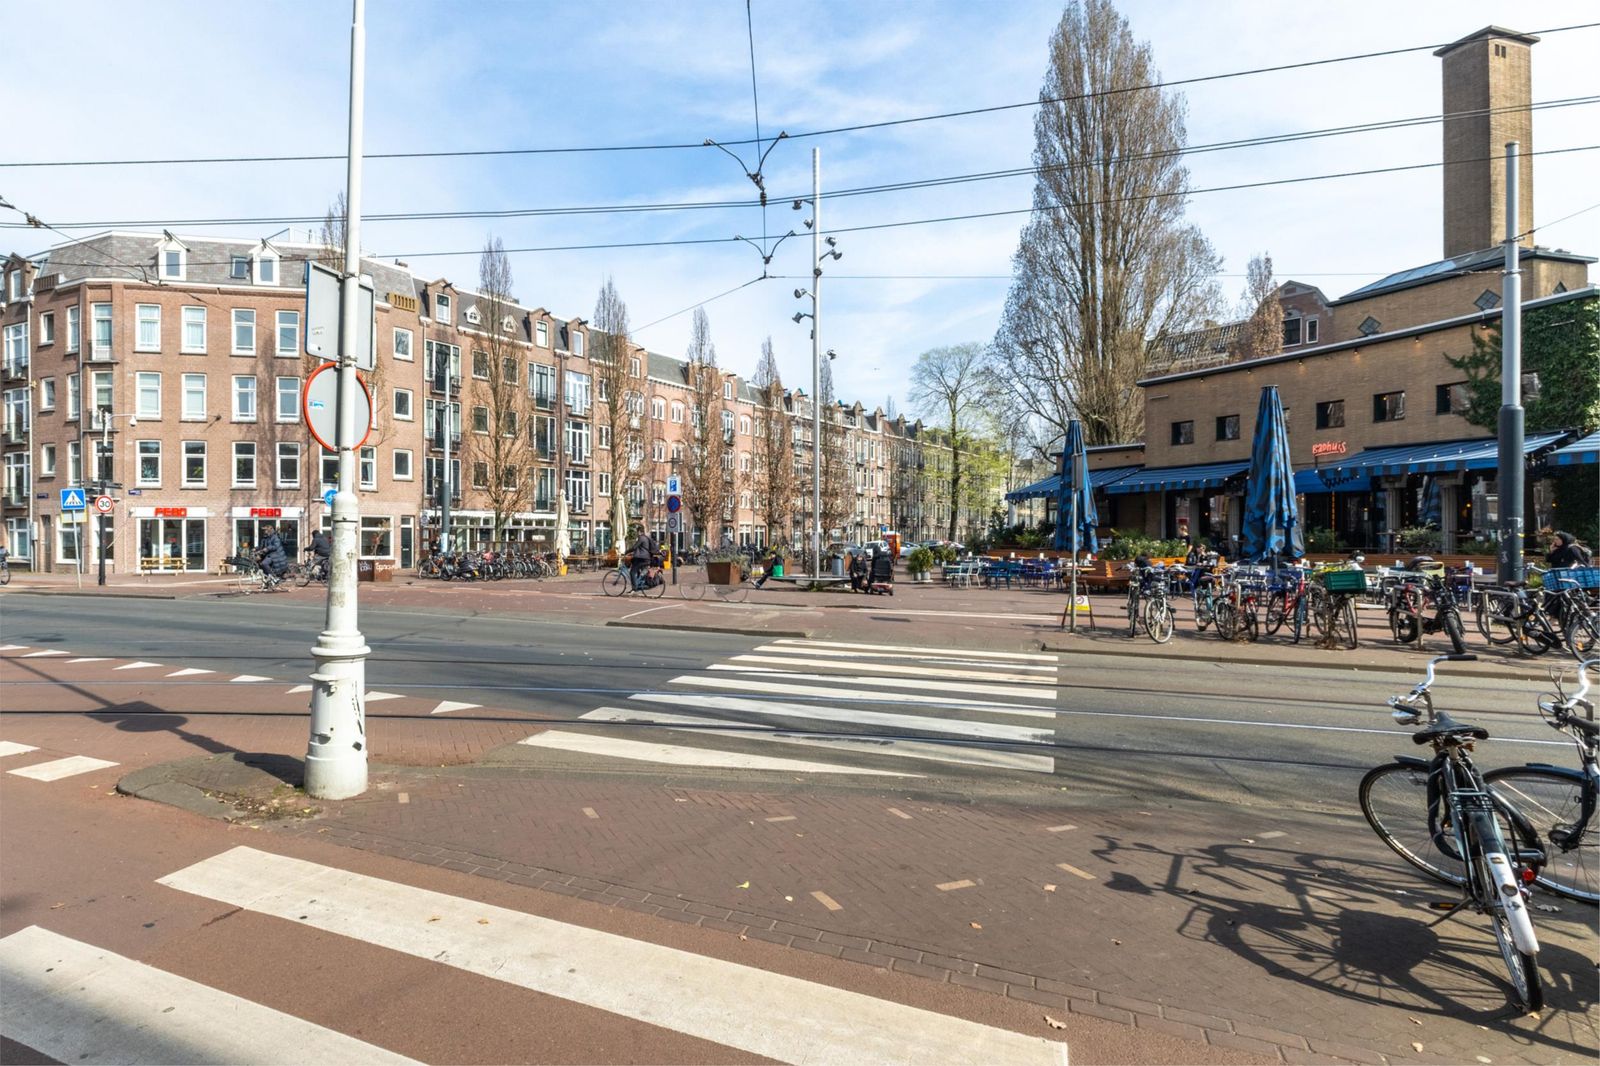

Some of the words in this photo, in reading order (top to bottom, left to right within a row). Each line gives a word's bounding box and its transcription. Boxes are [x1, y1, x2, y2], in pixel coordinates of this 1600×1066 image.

[100, 500, 110, 508] 30
[155, 507, 187, 517] FEBO
[250, 508, 281, 517] FEBO
